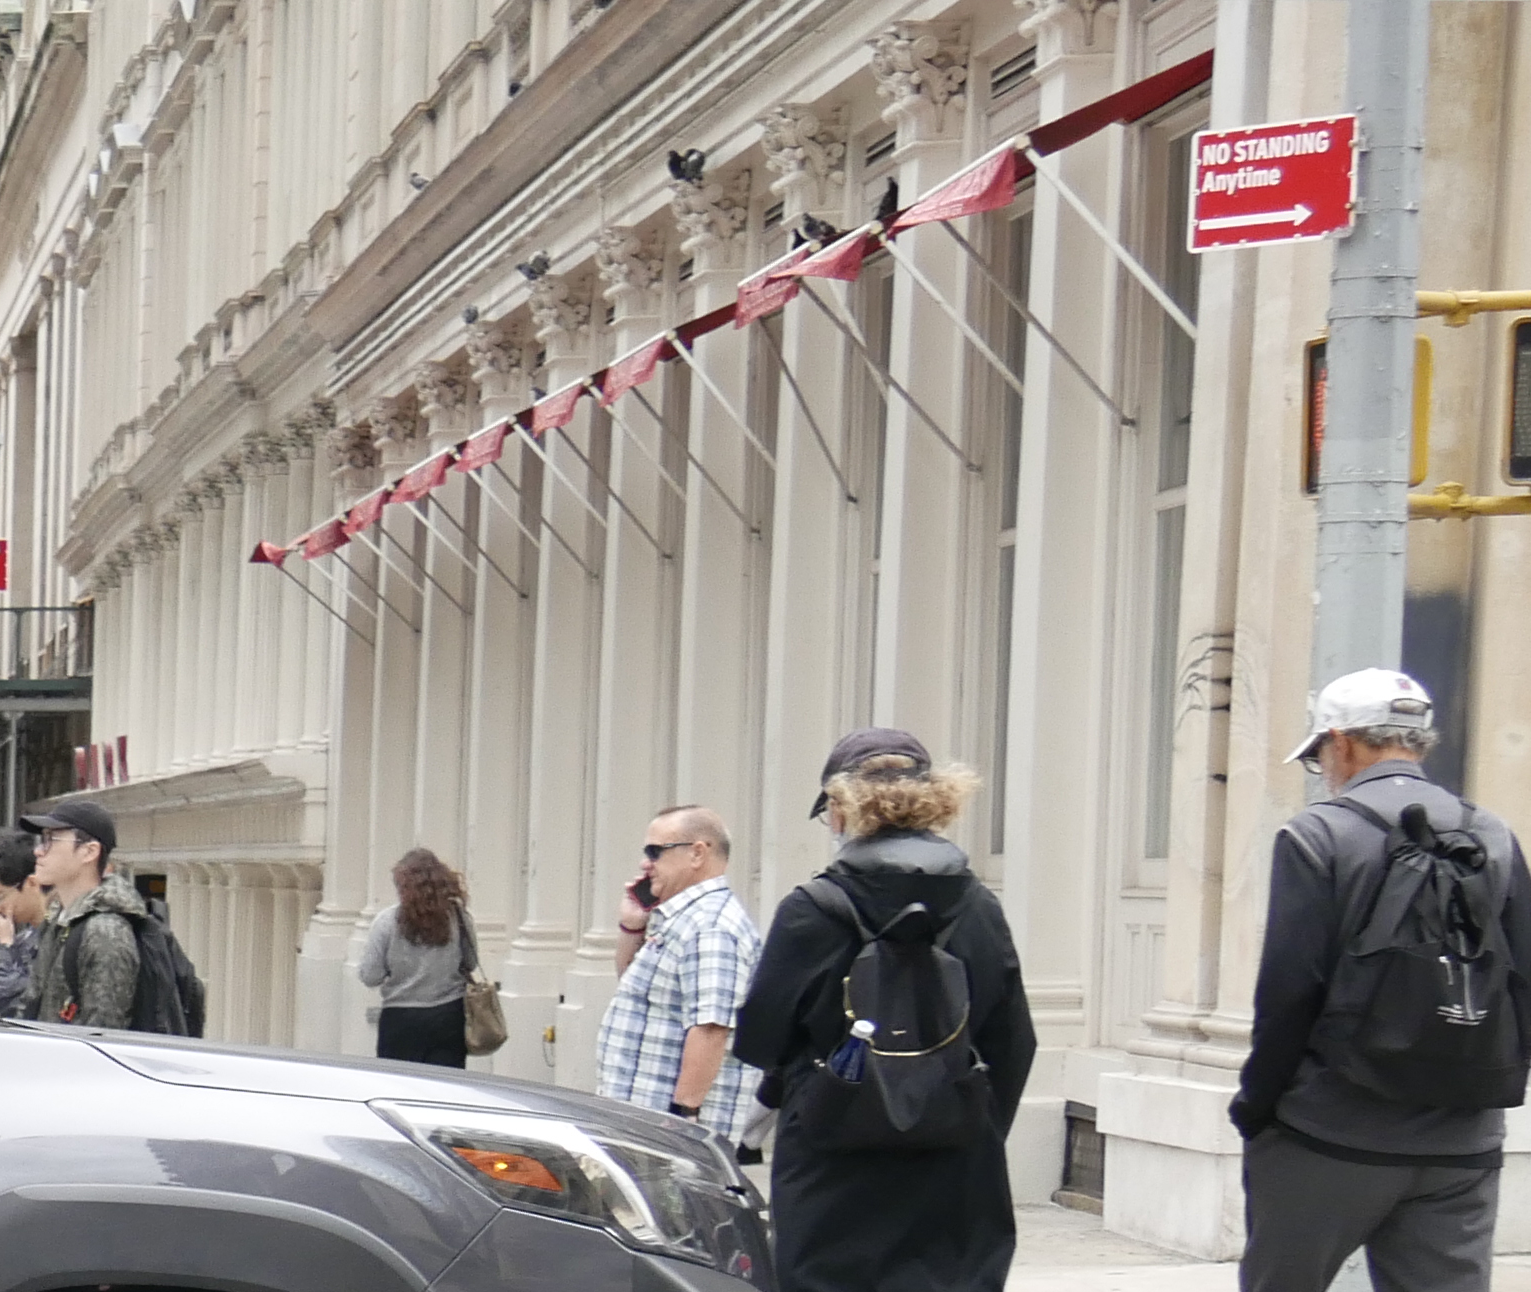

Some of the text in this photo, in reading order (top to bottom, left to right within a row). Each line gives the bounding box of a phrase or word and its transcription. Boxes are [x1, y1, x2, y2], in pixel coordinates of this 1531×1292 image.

[1202, 131, 1330, 166] NO STANDING
[1201, 166, 1282, 195] Anytime
